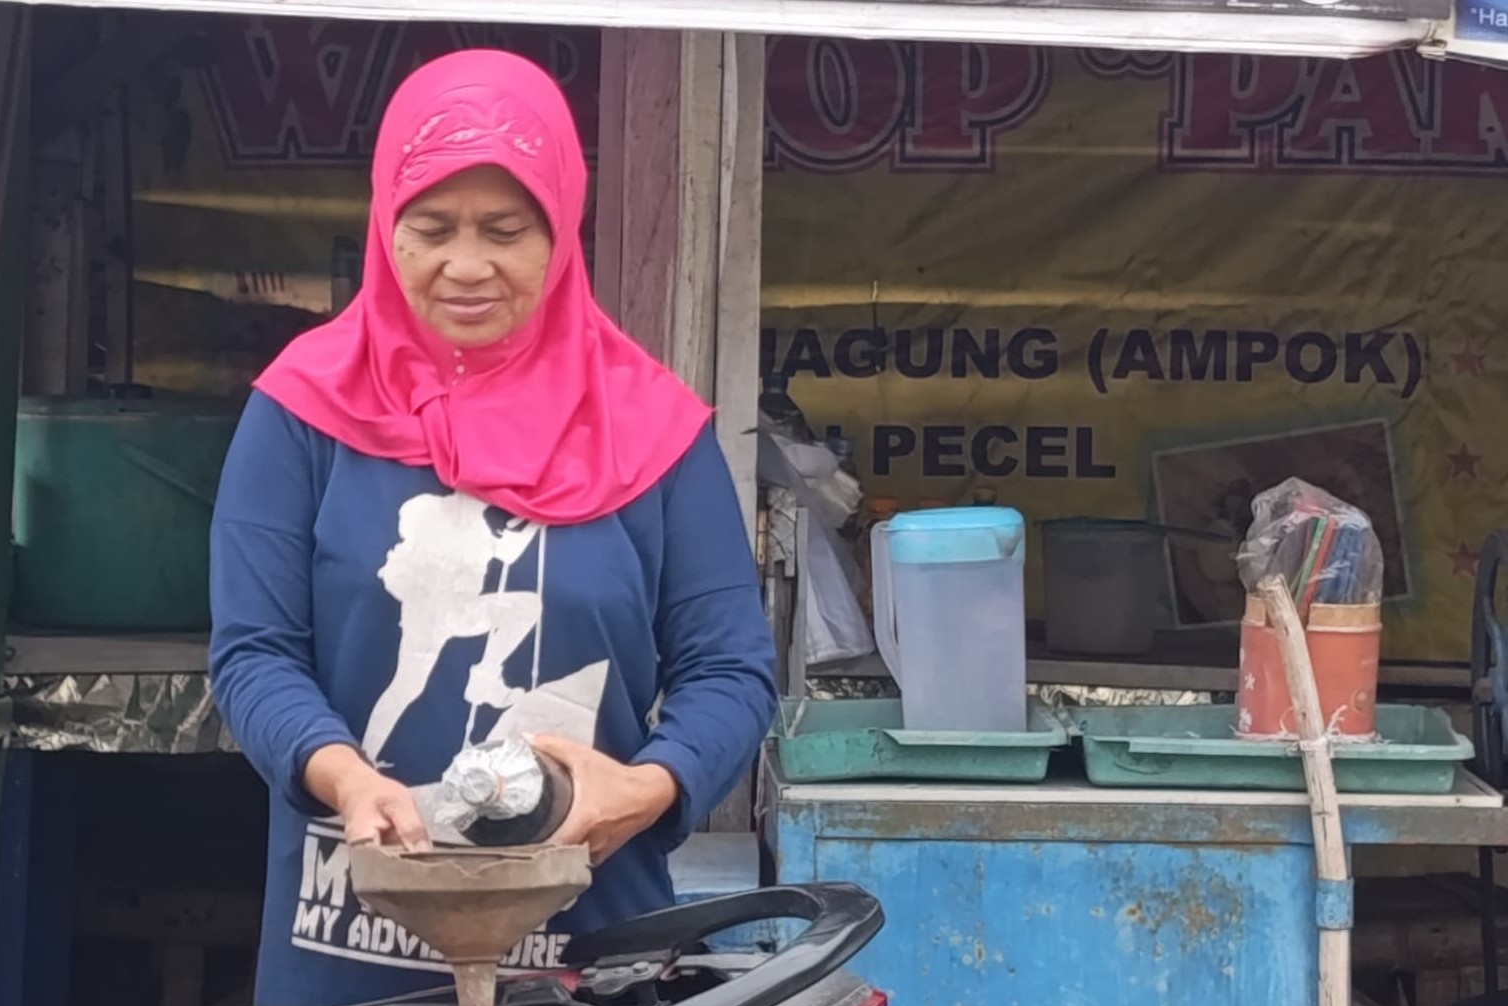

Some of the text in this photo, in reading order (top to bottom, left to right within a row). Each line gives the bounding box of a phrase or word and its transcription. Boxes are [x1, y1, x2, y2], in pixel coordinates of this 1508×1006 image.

[1089, 329, 1423, 398] (AMPOK)
[872, 425, 1116, 479] PECEL
[292, 901, 342, 942] MY
